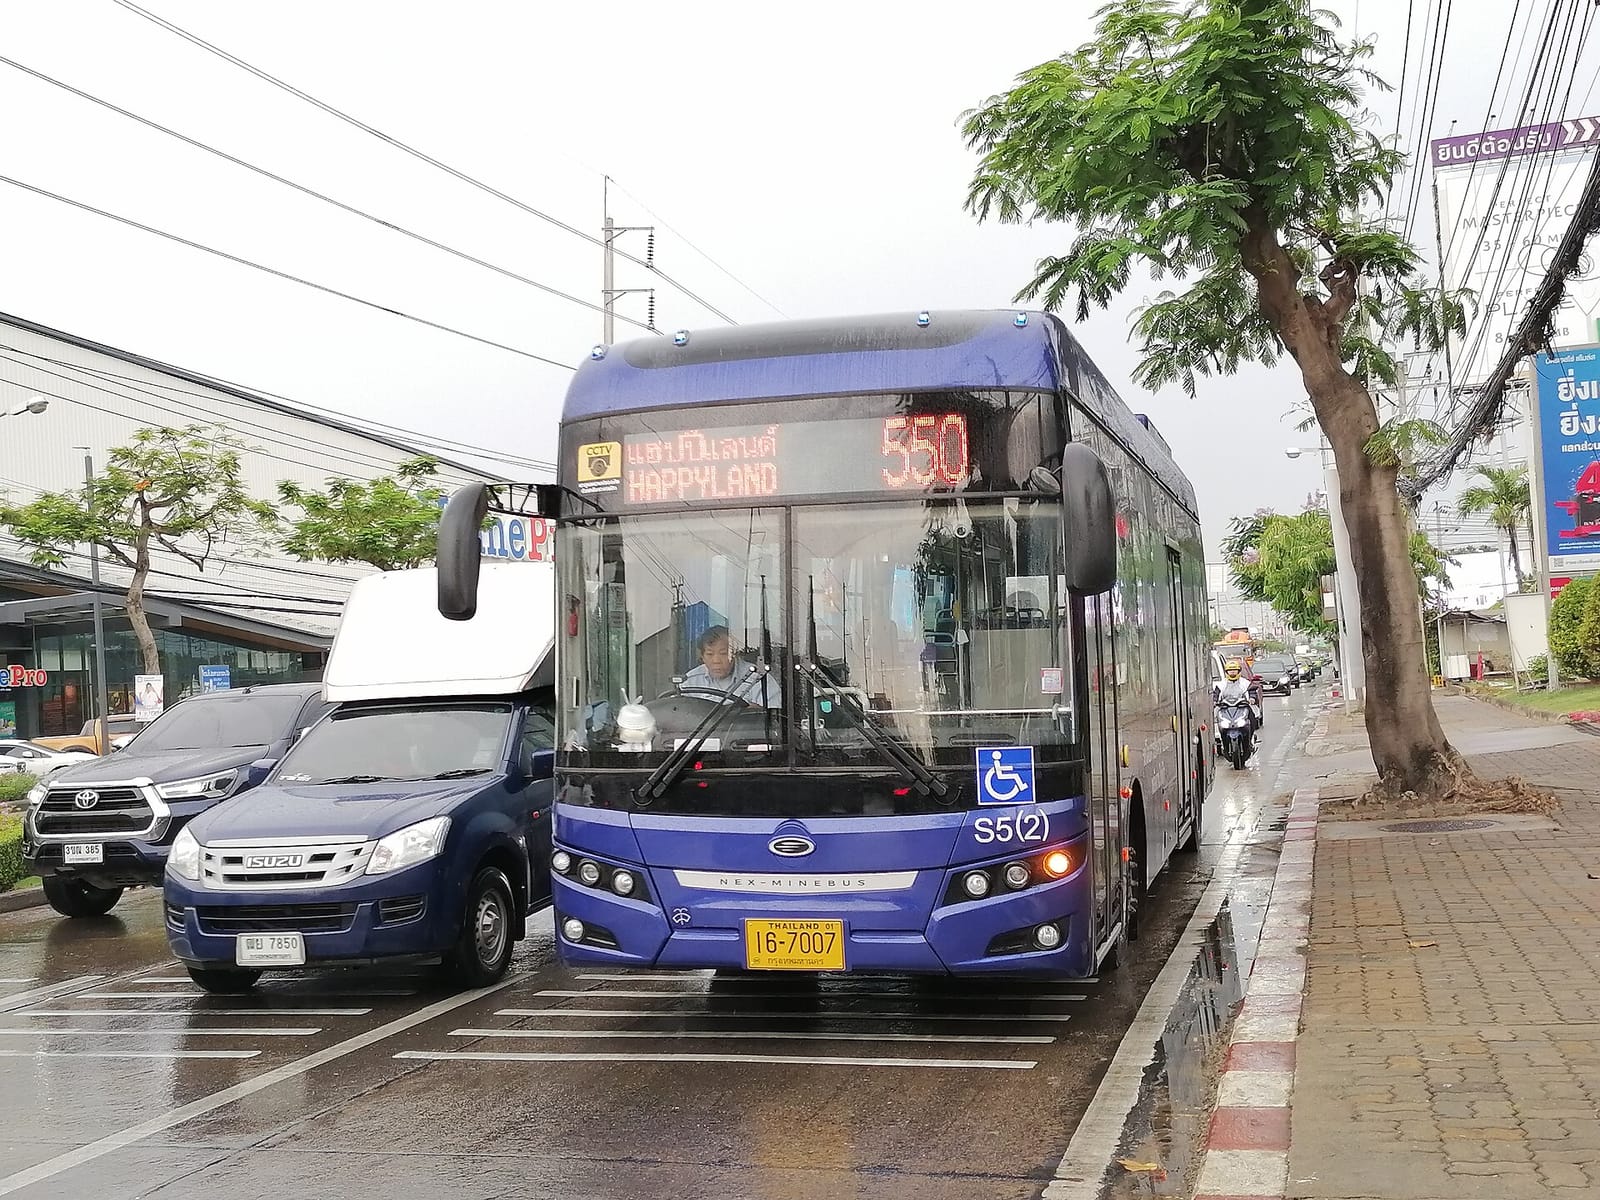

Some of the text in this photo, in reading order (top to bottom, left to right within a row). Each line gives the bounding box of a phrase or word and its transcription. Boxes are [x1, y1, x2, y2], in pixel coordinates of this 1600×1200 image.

[1438, 130, 1551, 161] ยินดีต้อนรับ
[586, 445, 612, 456] CCTV
[628, 424, 780, 464] แฮปปี้แลนด์
[882, 414, 969, 487] 550
[629, 462, 778, 501] HAPPYLAND
[974, 808, 1050, 844] S5(2)
[246, 855, 303, 868] ISUZU
[720, 878, 866, 887] NEX-MINEBUS
[768, 922, 819, 930] THAILAND
[269, 937, 298, 950] 7850
[757, 931, 836, 954] 16-7007
